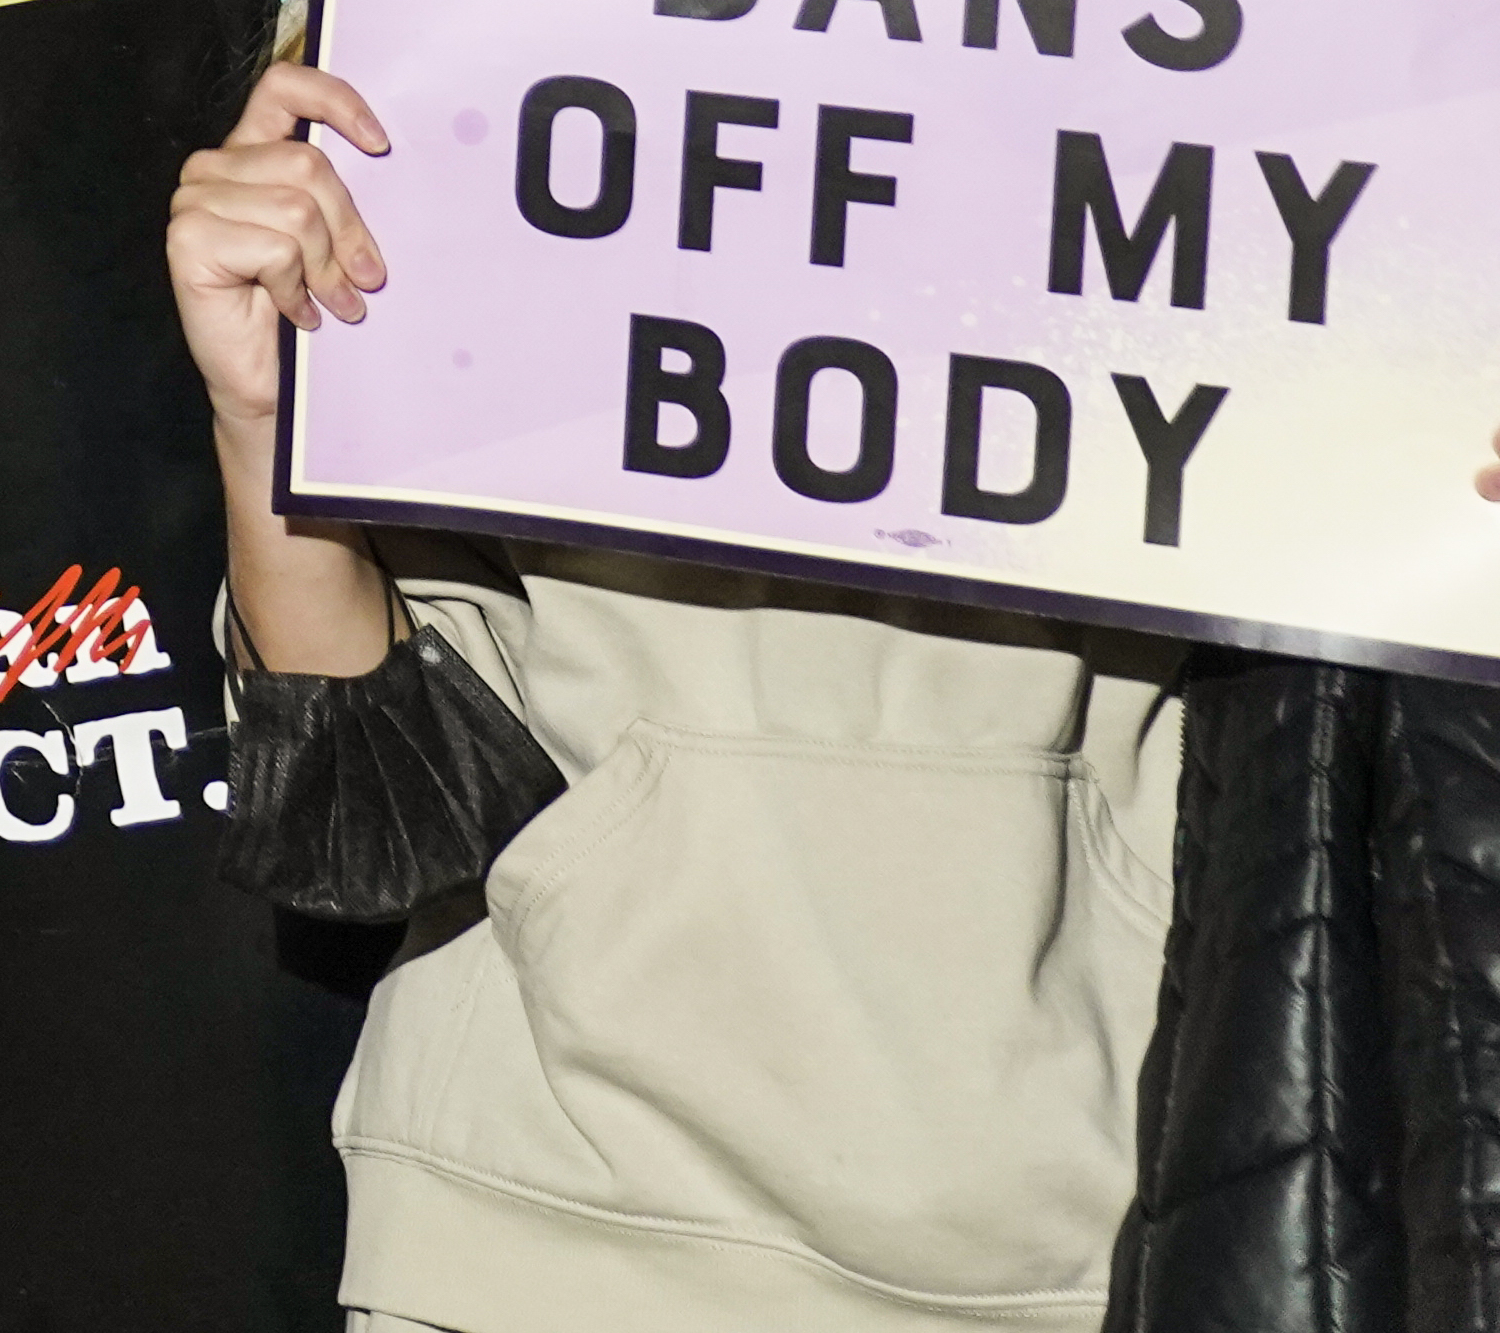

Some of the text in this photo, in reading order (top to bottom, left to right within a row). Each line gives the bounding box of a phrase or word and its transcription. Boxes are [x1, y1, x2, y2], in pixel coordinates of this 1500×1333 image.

[514, 74, 1378, 328] OFF MY
[620, 311, 1231, 550] BODY
